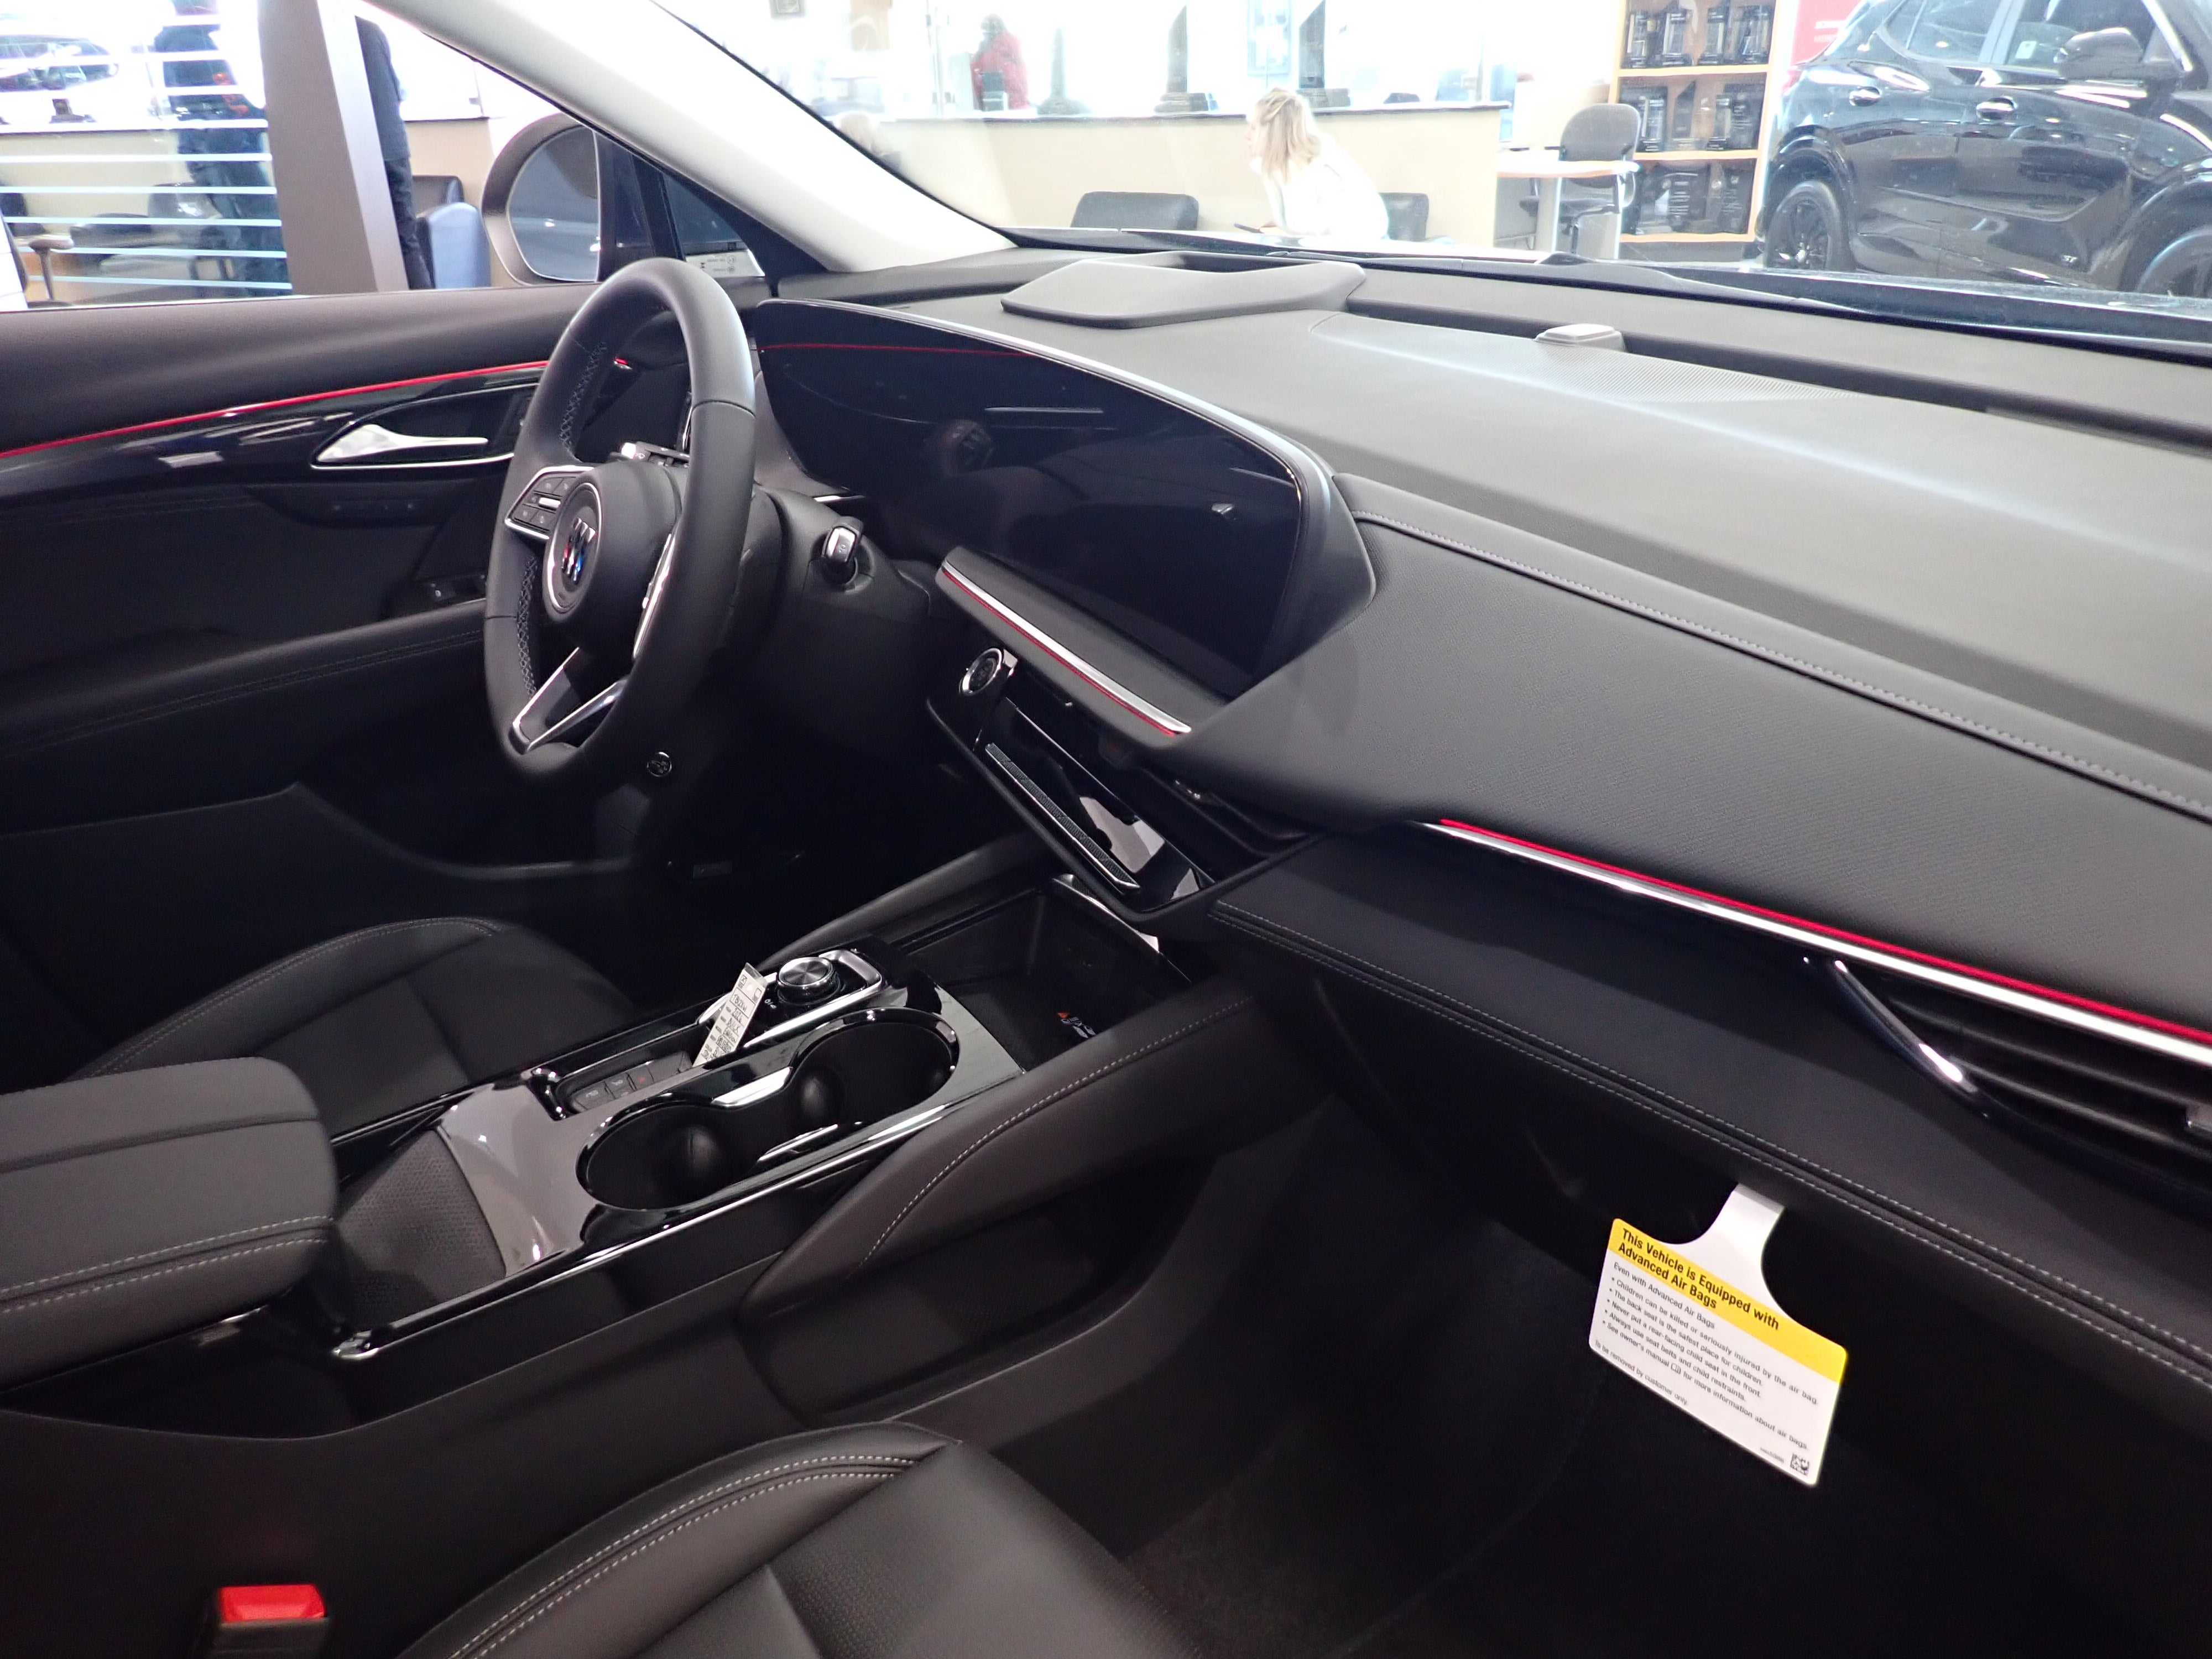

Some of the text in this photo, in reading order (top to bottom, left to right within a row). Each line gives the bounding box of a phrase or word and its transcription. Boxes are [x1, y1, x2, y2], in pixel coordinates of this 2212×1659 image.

[1614, 1261, 1715, 1329] Even with Advanced Air Bags
[1618, 1242, 1717, 1309] Advanced Air Bags
[1623, 1228, 1779, 1330] This Vehicle is Equipped with
[1601, 1344, 1609, 1354] be
[1610, 1351, 1635, 1372] removed
[1636, 1368, 1644, 1378] by
[1609, 1312, 1631, 1331] Always
[1632, 1328, 1644, 1339] use
[1645, 1336, 1660, 1349] seat
[1678, 1357, 1692, 1368] and
[1693, 1366, 1710, 1379] child
[1611, 1301, 1630, 1316] Never
[1631, 1314, 1642, 1325] put
[1686, 1349, 1703, 1363] child
[1704, 1360, 1719, 1373] seat
[1720, 1369, 1728, 1378] in
[1729, 1374, 1741, 1386] the
[1615, 1290, 1626, 1302] The
[1626, 1298, 1642, 1313] back
[1643, 1310, 1658, 1322] seat
[1658, 1318, 1665, 1327] is
[1666, 1323, 1677, 1334] the
[1678, 1332, 1699, 1348] safest
[1700, 1345, 1719, 1360] place
[1721, 1356, 1731, 1367] for
[1616, 1279, 1644, 1301] Children
[1645, 1298, 1657, 1310] can
[1659, 1306, 1668, 1316] be
[1762, 1368, 1772, 1379] by
[1774, 1375, 1787, 1387] the
[1788, 1385, 1799, 1394] air
[1607, 1322, 1619, 1335] See
[1646, 1349, 1670, 1367] manual
[1683, 1371, 1693, 1381] for
[1694, 1379, 1711, 1394] more
[1713, 1390, 1752, 1418] information
[1754, 1416, 1775, 1432] about
[1777, 1430, 1787, 1438] air
